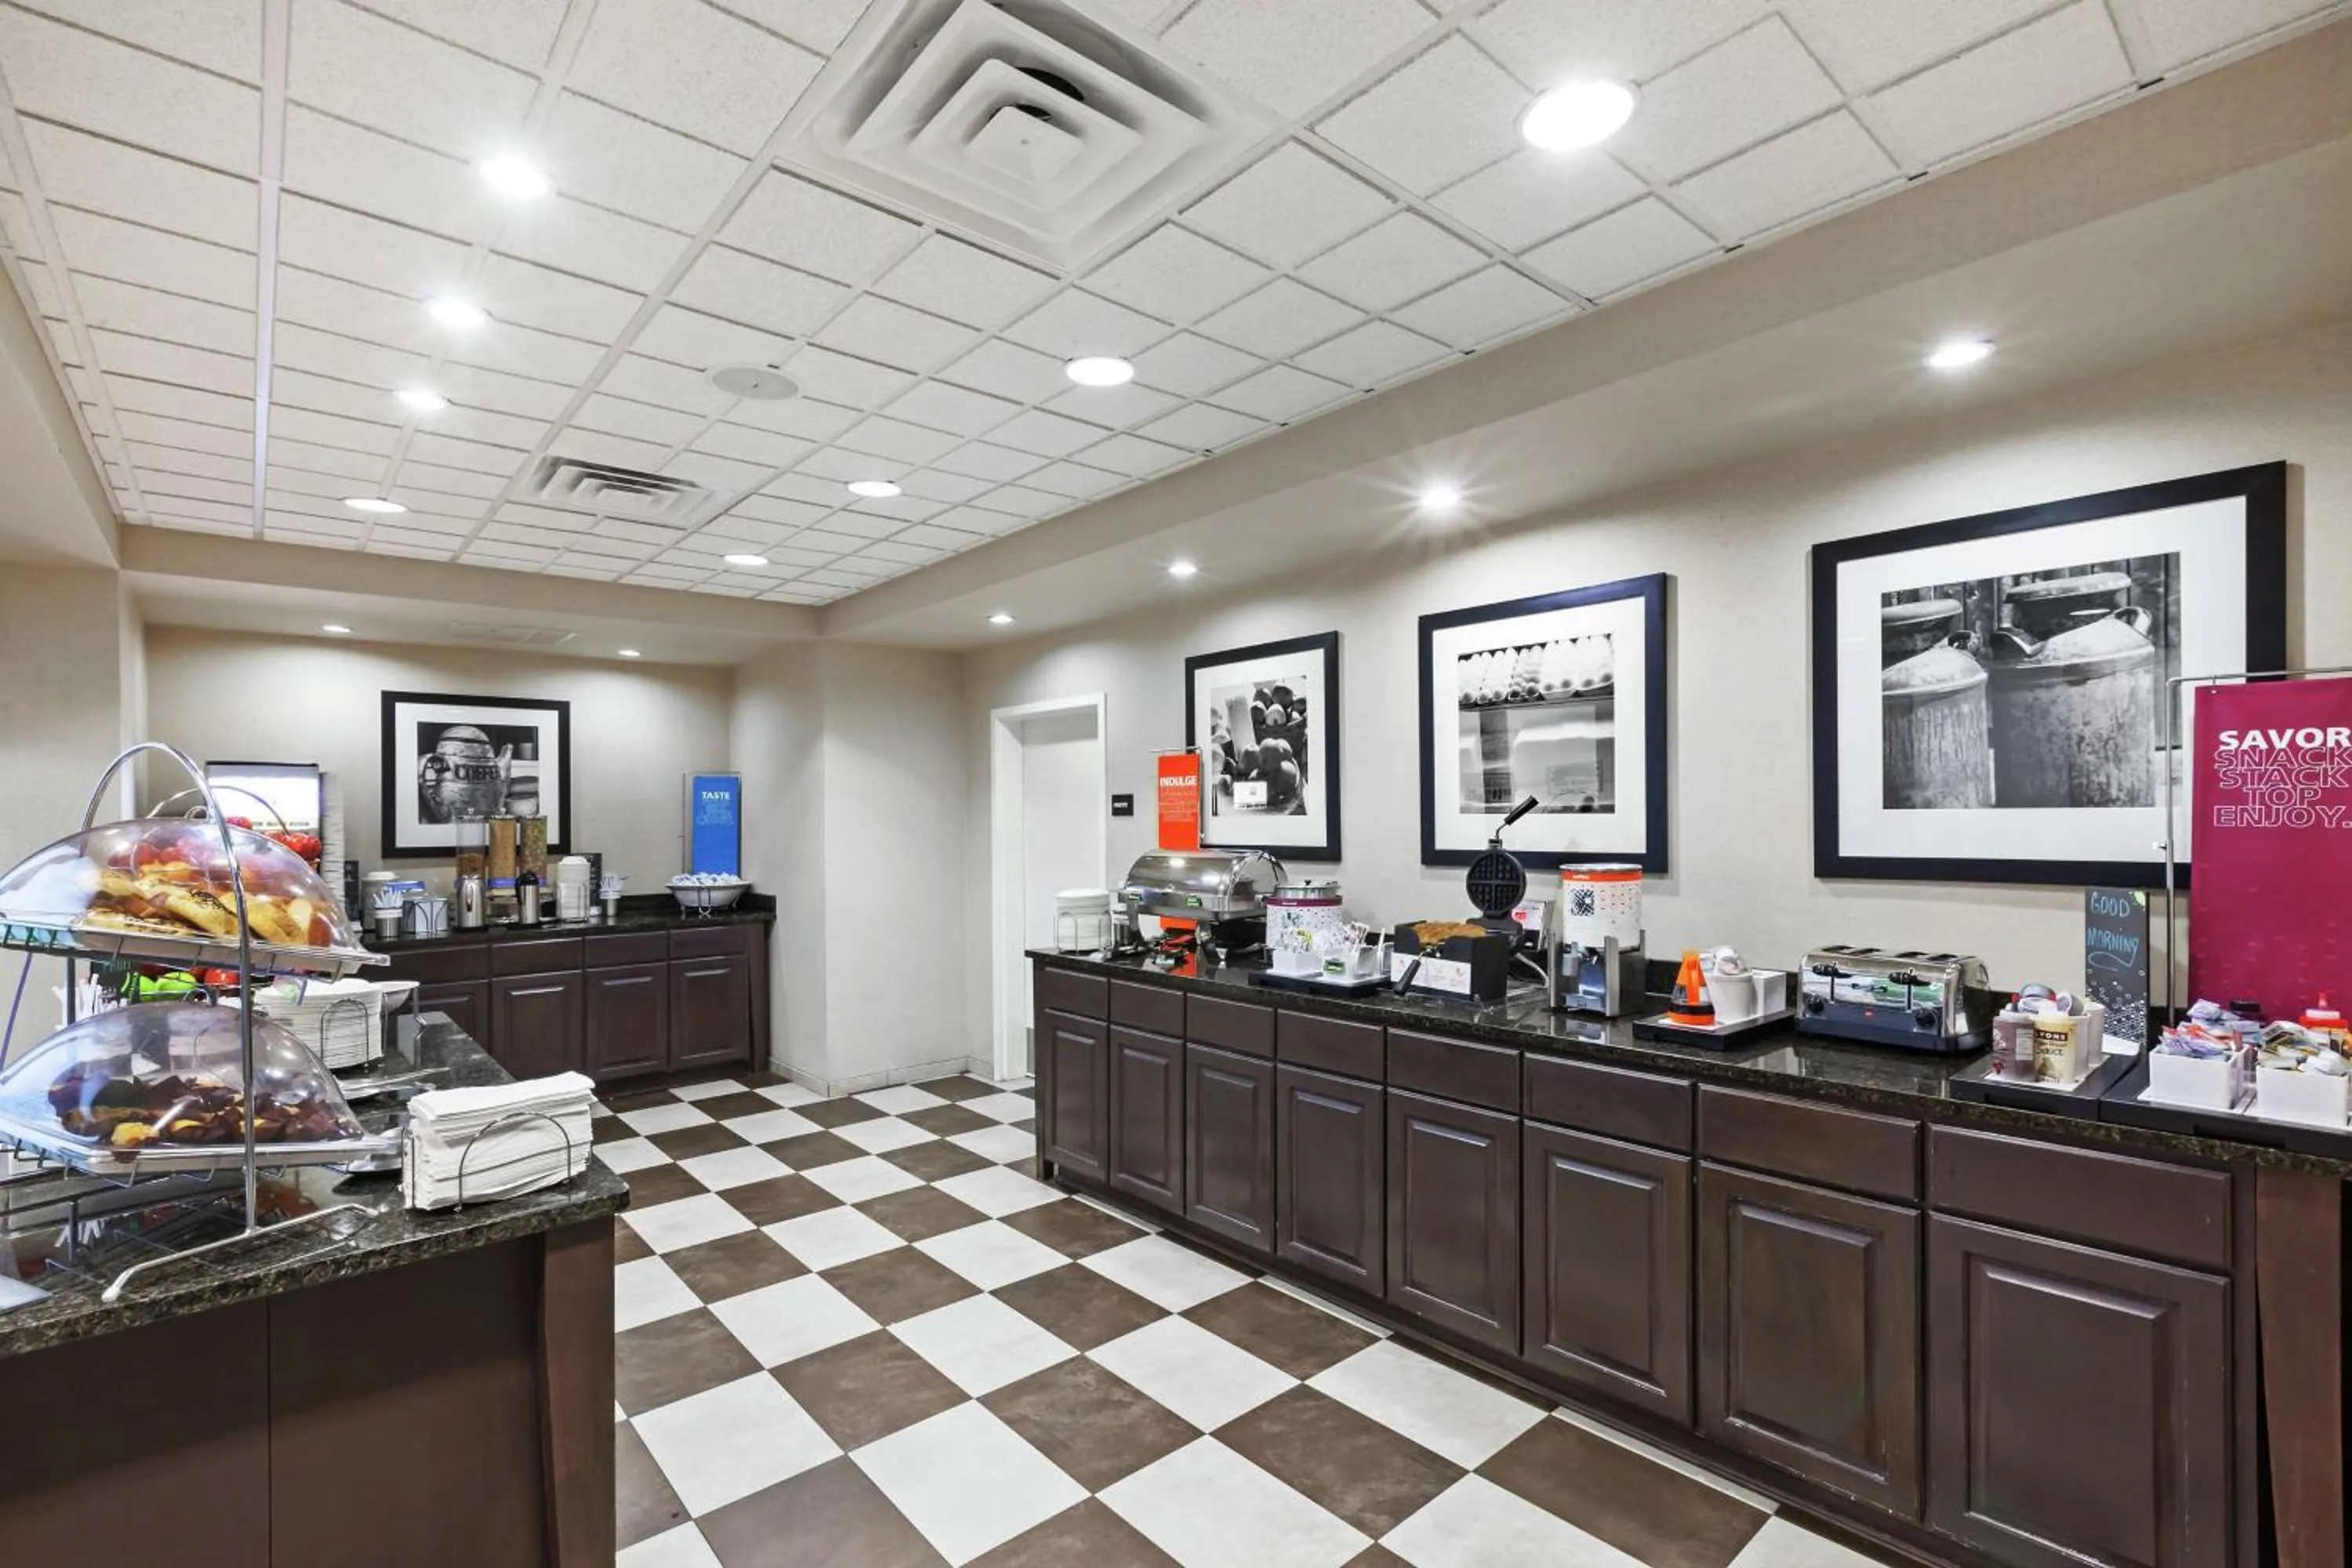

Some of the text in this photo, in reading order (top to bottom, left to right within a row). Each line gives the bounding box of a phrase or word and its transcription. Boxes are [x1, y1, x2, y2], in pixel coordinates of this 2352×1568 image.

[2219, 727, 2352, 750] SAVOR
[2214, 746, 2352, 768] SNACK
[1160, 775, 1197, 787] INDULGE
[2220, 766, 2349, 788] STACK
[702, 791, 731, 800] TASTE
[2243, 786, 2321, 808] TOP
[2214, 805, 2352, 829] ENJOY.
[2091, 891, 2130, 917] GOOD
